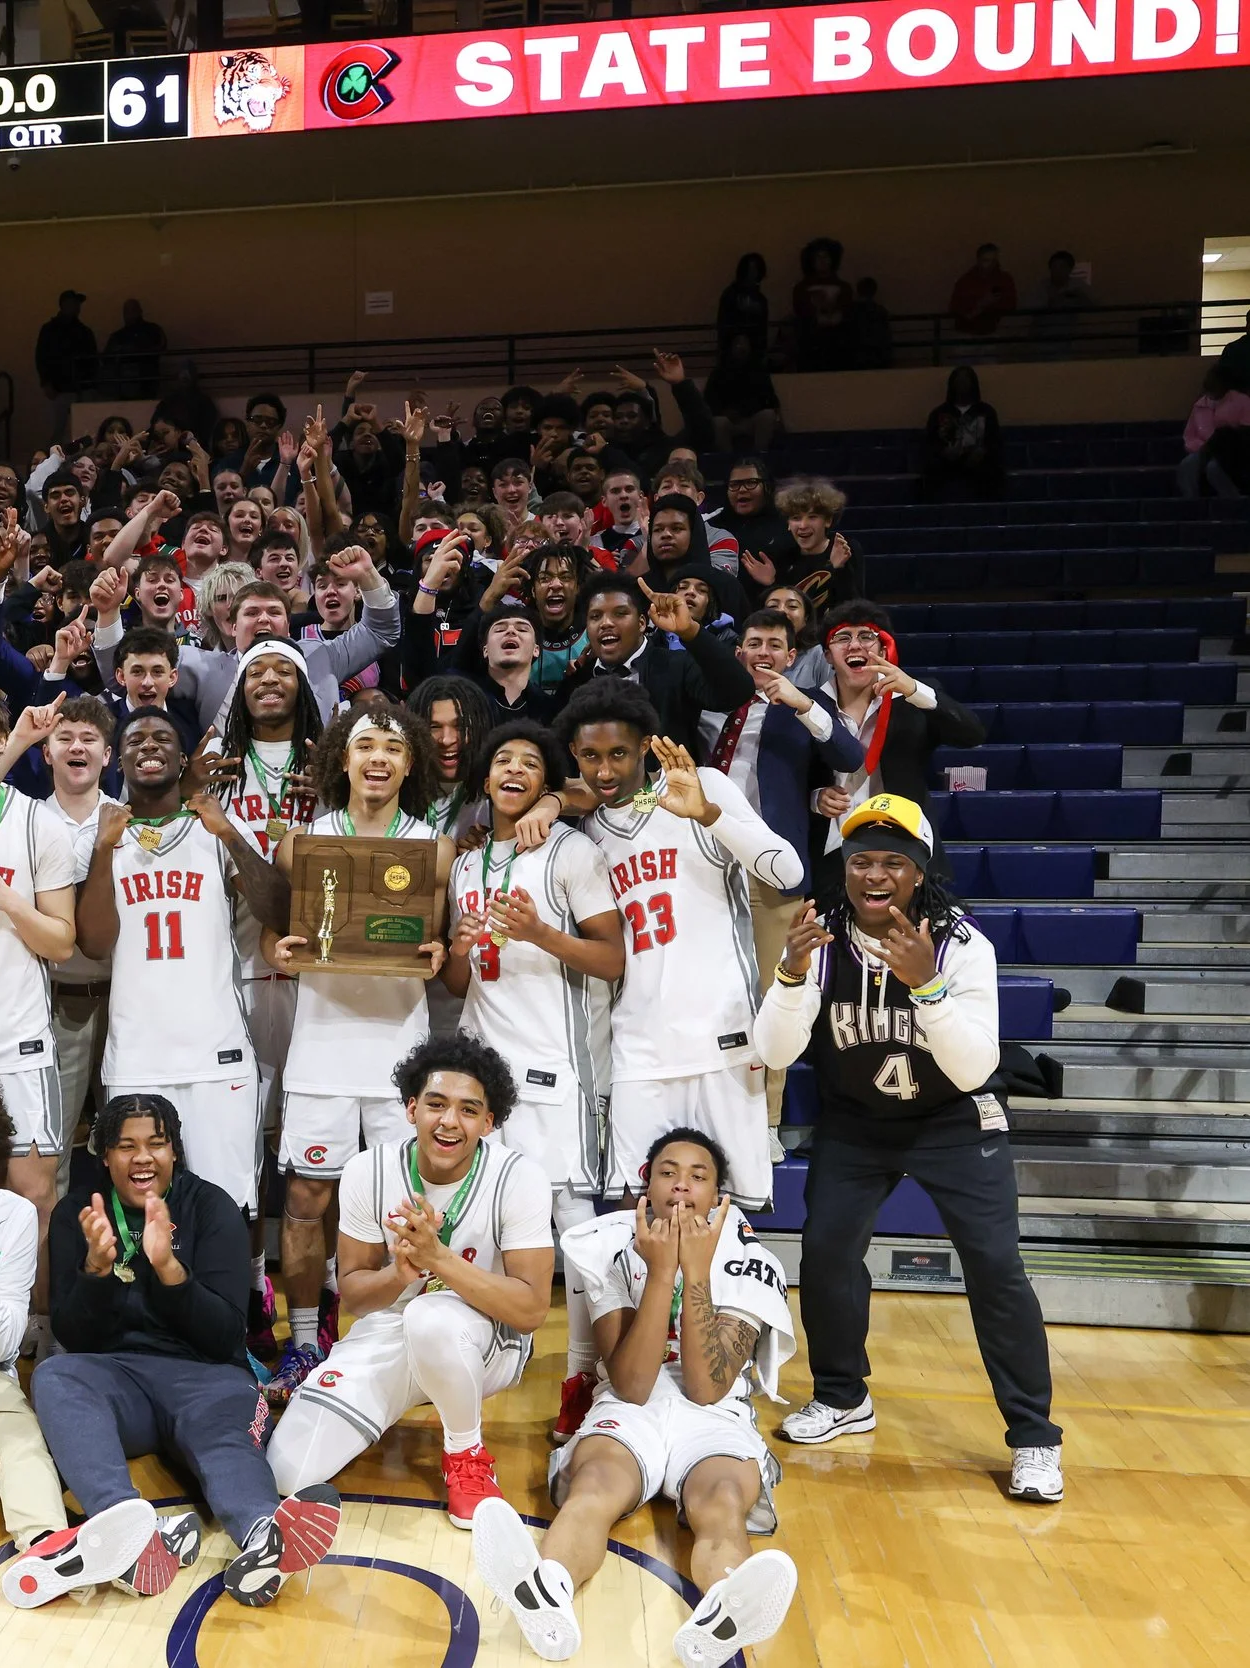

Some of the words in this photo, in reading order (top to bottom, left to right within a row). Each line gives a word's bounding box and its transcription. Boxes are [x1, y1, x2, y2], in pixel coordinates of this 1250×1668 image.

[455, 22, 771, 107] STATE
[812, 0, 1240, 82] BOUND!
[108, 74, 180, 127] 61
[8, 122, 62, 148] QTR
[120, 870, 205, 906] IRISH
[144, 910, 185, 961] 11
[624, 891, 678, 955] 23
[872, 1052, 920, 1101] 4
